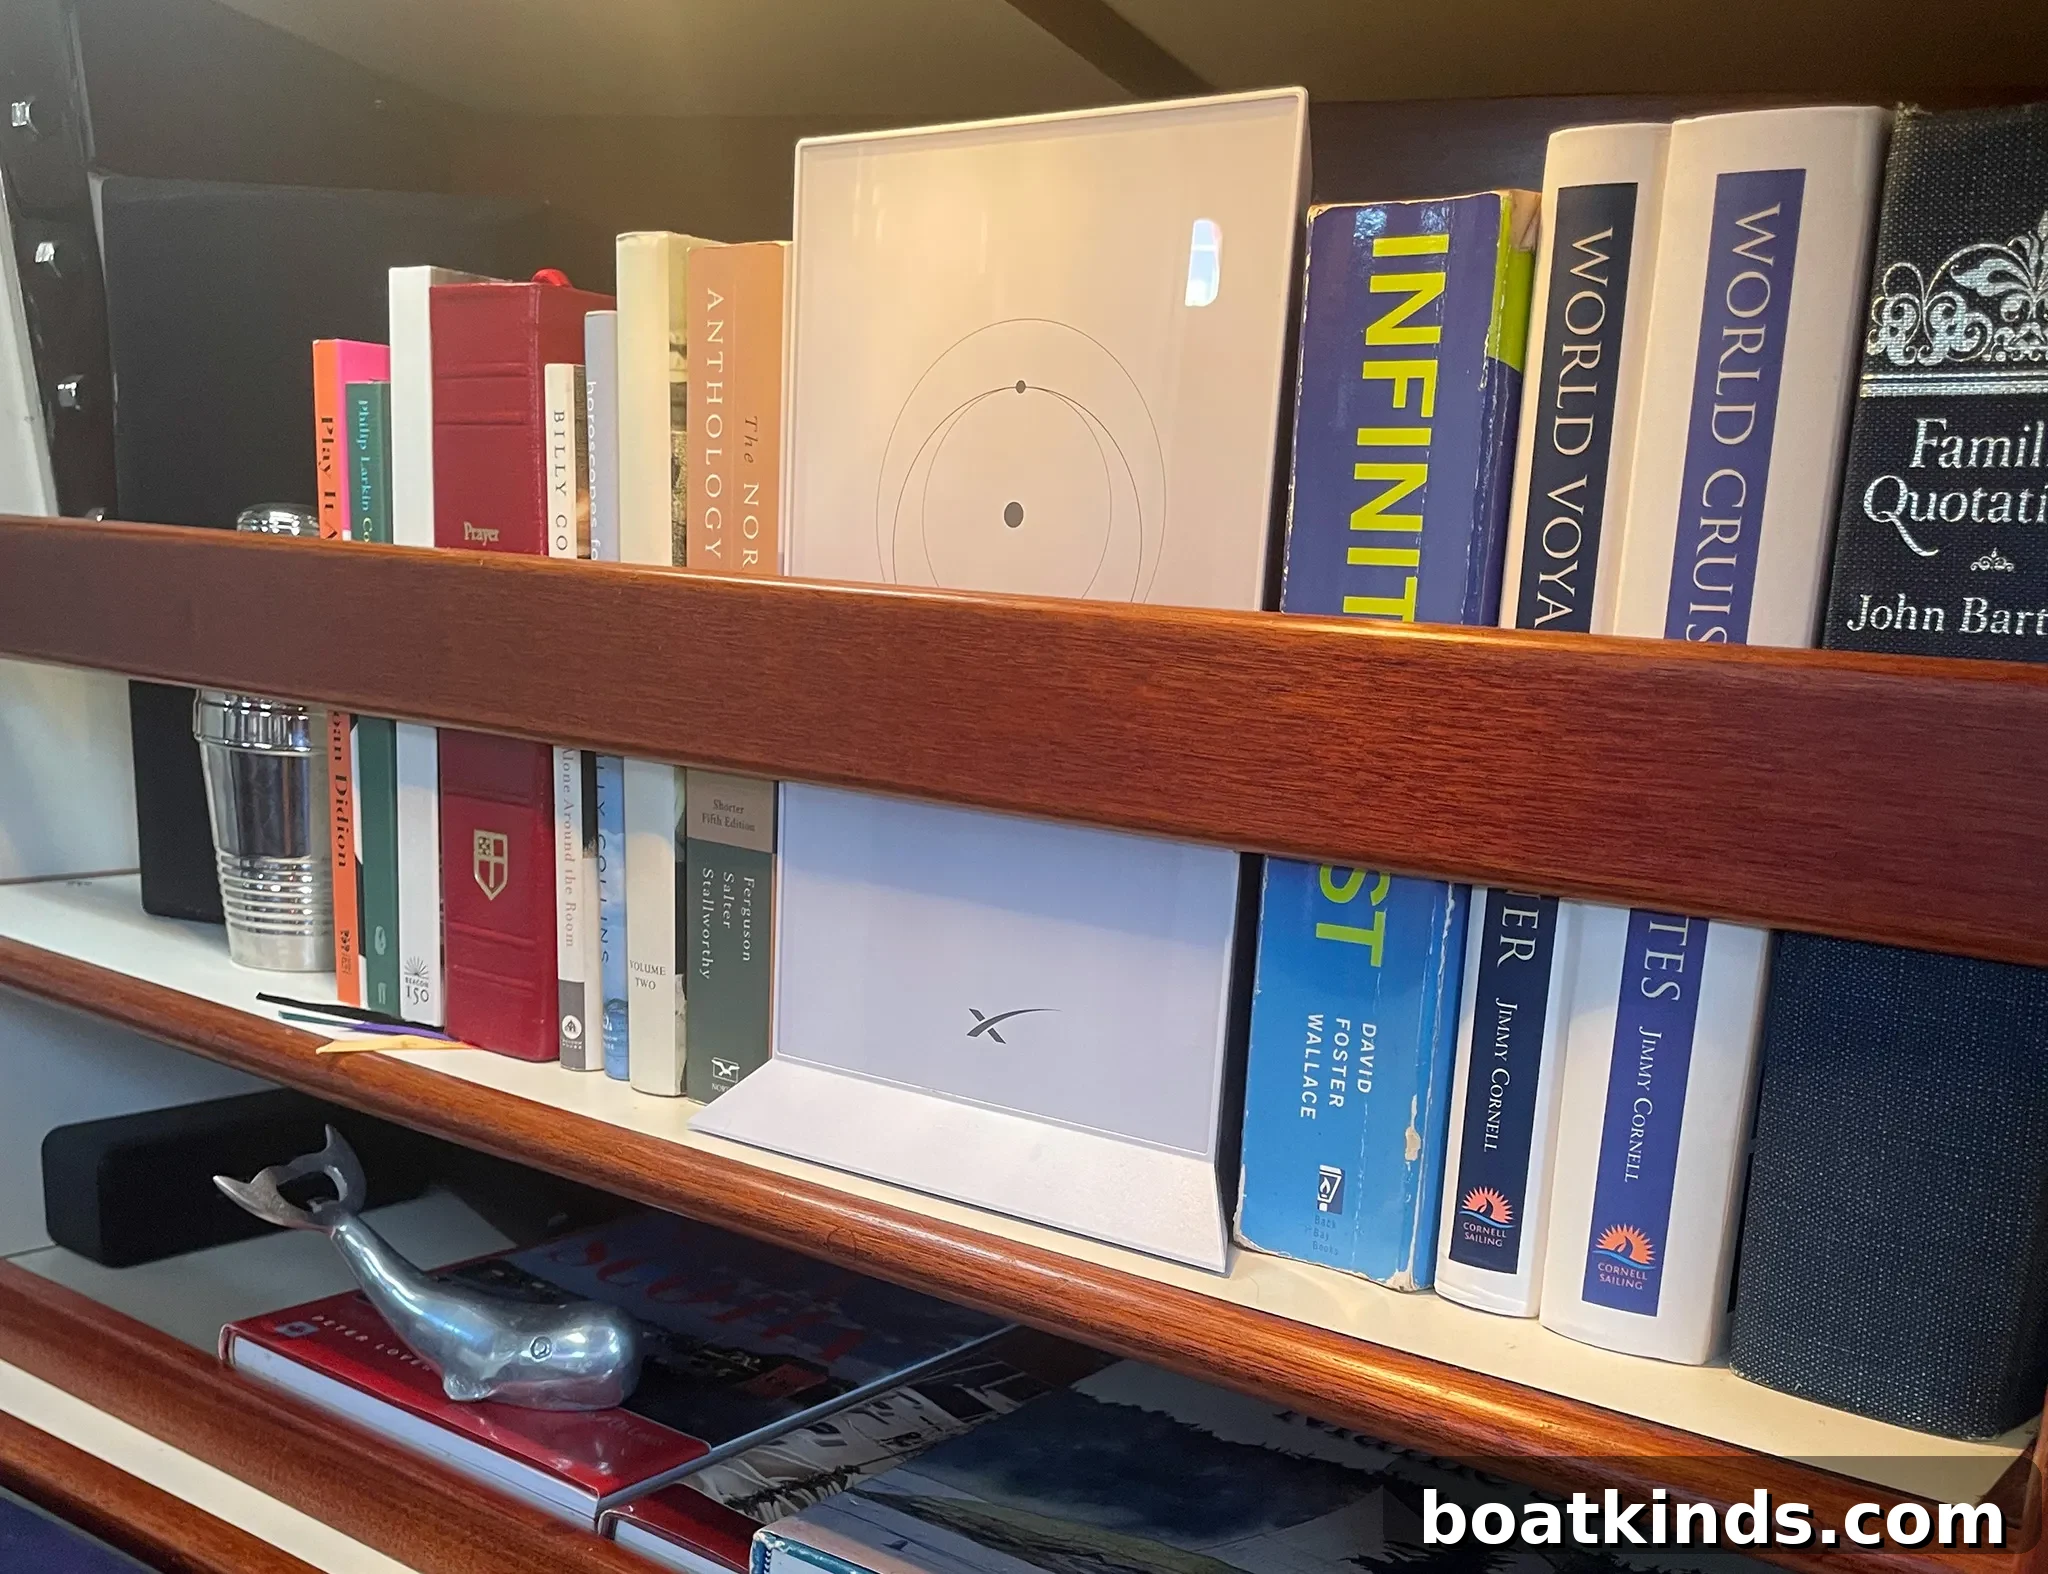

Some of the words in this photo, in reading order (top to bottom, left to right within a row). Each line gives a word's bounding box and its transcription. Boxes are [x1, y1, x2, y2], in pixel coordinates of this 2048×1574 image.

[1552, 227, 1613, 456] WORLD
[1711, 202, 1781, 446] WORLD
[318, 417, 334, 479] Play
[357, 400, 371, 450] Philip
[553, 410, 567, 496] BILLY
[704, 287, 724, 559] ANTHOLOGY
[743, 415, 759, 464] The
[1342, 233, 1450, 622] INFINIT
[1908, 417, 2045, 468] Famil
[360, 457, 372, 511] Larkin
[586, 381, 597, 528] horoscopes
[324, 491, 336, 509] It
[363, 517, 373, 542] Co
[742, 483, 760, 568] NOR
[463, 521, 500, 546] Prayer
[555, 514, 568, 551] CO
[1534, 475, 1588, 628] VOYA
[1846, 593, 1945, 632] John
[1958, 596, 2048, 636] Bart
[335, 774, 349, 867] Didion
[564, 798, 576, 862] Around
[702, 812, 722, 827] Fifth
[724, 816, 756, 832] Edition
[713, 799, 745, 814] Shorter
[564, 869, 576, 895] the
[723, 871, 735, 929] Salter
[565, 902, 577, 948] Room
[699, 867, 714, 980] Stallworthy
[741, 875, 755, 962] Ferguson
[1315, 864, 1392, 968] ST
[630, 959, 666, 975] VOLUME
[635, 976, 656, 990] TWO
[1640, 917, 1690, 1002] TES
[1357, 1022, 1378, 1094] DAVID
[1492, 997, 1518, 1060] JIMMY
[1634, 1026, 1663, 1090] JIMMY
[1299, 1013, 1325, 1120] WALLACE
[1328, 1016, 1351, 1109] FOSTER
[1484, 1068, 1513, 1153] CORNELL
[1624, 1098, 1654, 1183] CORNELL
[1463, 1222, 1507, 1239] CORNELL
[1464, 1231, 1503, 1248] SAILING
[1597, 1262, 1648, 1281] CORNELL
[1599, 1273, 1643, 1291] SAILING
